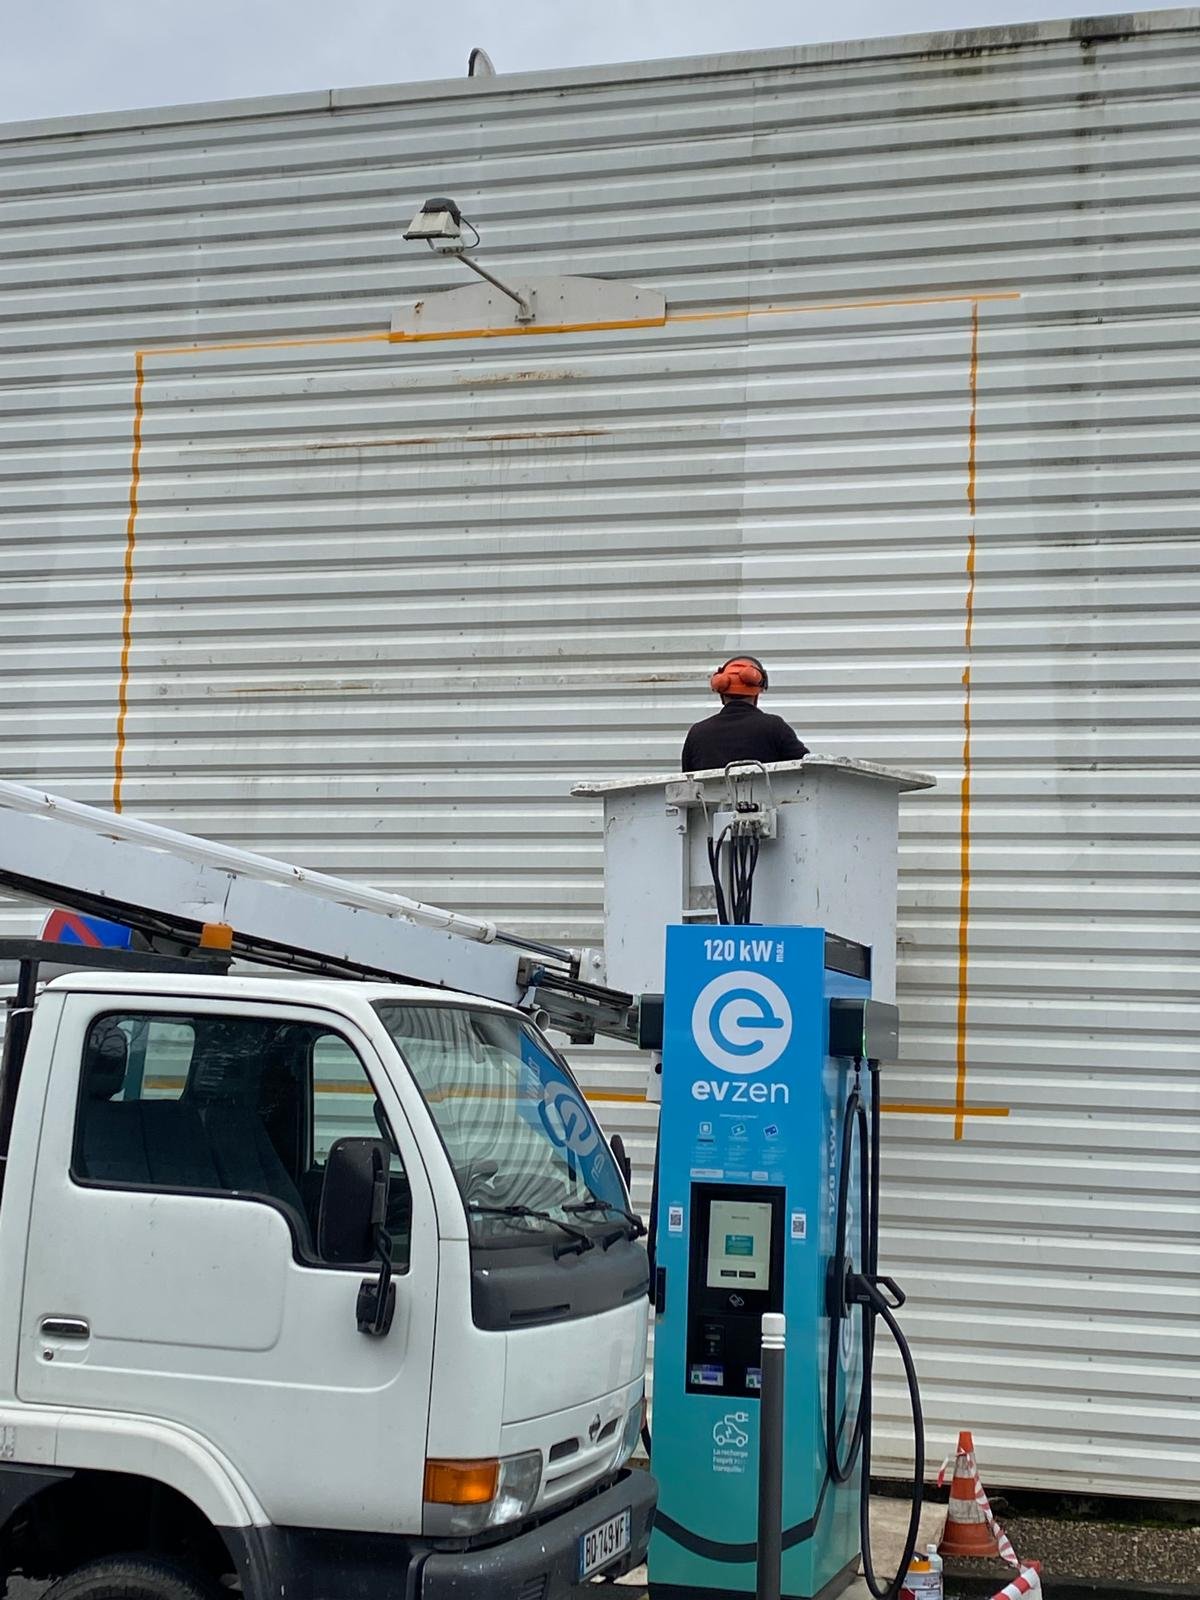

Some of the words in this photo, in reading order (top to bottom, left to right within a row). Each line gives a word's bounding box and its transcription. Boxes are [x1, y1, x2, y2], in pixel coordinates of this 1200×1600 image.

[704, 939, 735, 961] 120
[739, 940, 773, 963] kW
[691, 1080, 789, 1104] evzen
